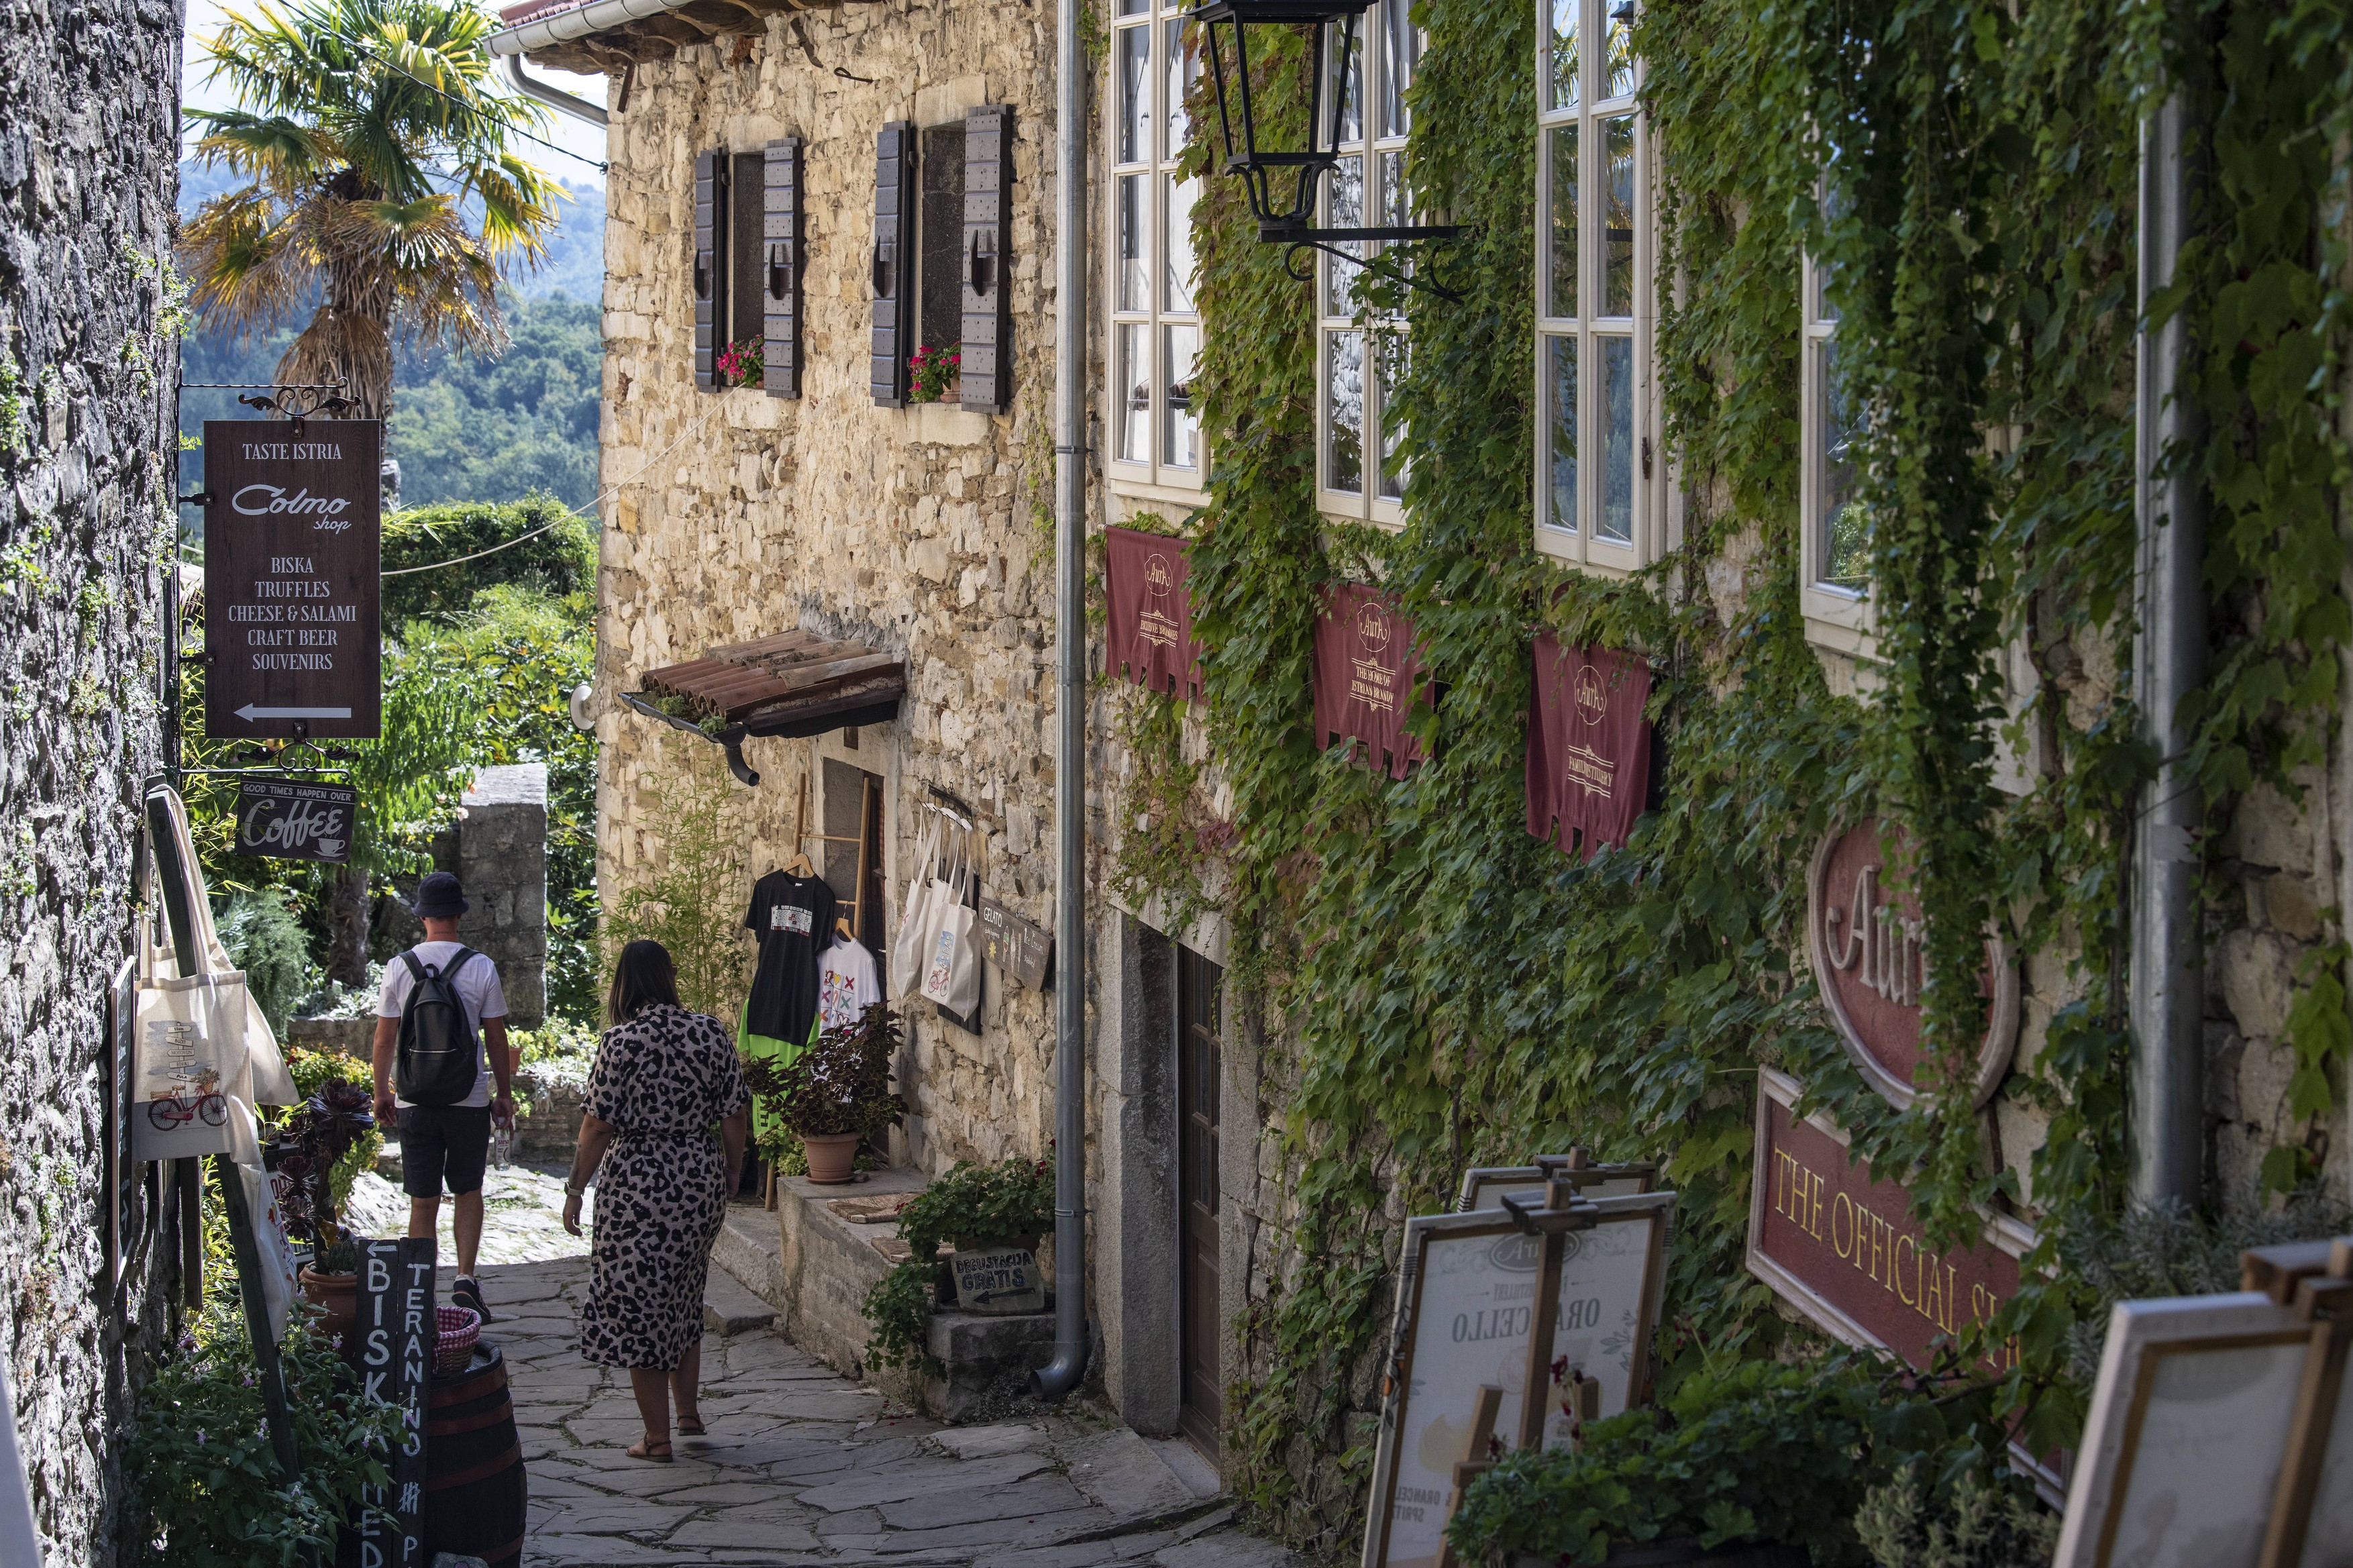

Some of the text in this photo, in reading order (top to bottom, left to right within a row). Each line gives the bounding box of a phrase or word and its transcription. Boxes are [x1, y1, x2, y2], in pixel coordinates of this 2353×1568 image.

[242, 443, 342, 460] TASTE ISTRIA
[231, 484, 351, 515] Colmo
[313, 516, 352, 534] shop
[270, 557, 314, 574] BISKA
[254, 580, 330, 598] TRUFFLES
[228, 605, 357, 622] CHEESE & SALAMI
[247, 629, 338, 645] CRAFT BEER
[252, 654, 333, 670] SOUVENIRS
[1356, 666, 1392, 686] THE HOME OF
[1351, 679, 1394, 704] ISTRIAN BRANDY
[1569, 755, 1585, 774] FAMIL
[243, 784, 352, 802] GOOD TIMES HAPPEN OVER
[243, 798, 344, 849] Coffee
[984, 906, 1002, 927] GELATO
[1826, 864, 1927, 1007] Aur
[1774, 1142, 1824, 1246] THE
[1832, 1192, 1961, 1337] OFFICIAL
[955, 1252, 1031, 1273] DEGUSTACIJA
[961, 1268, 1026, 1292] GRATIS
[403, 1263, 431, 1457] TERANINO
